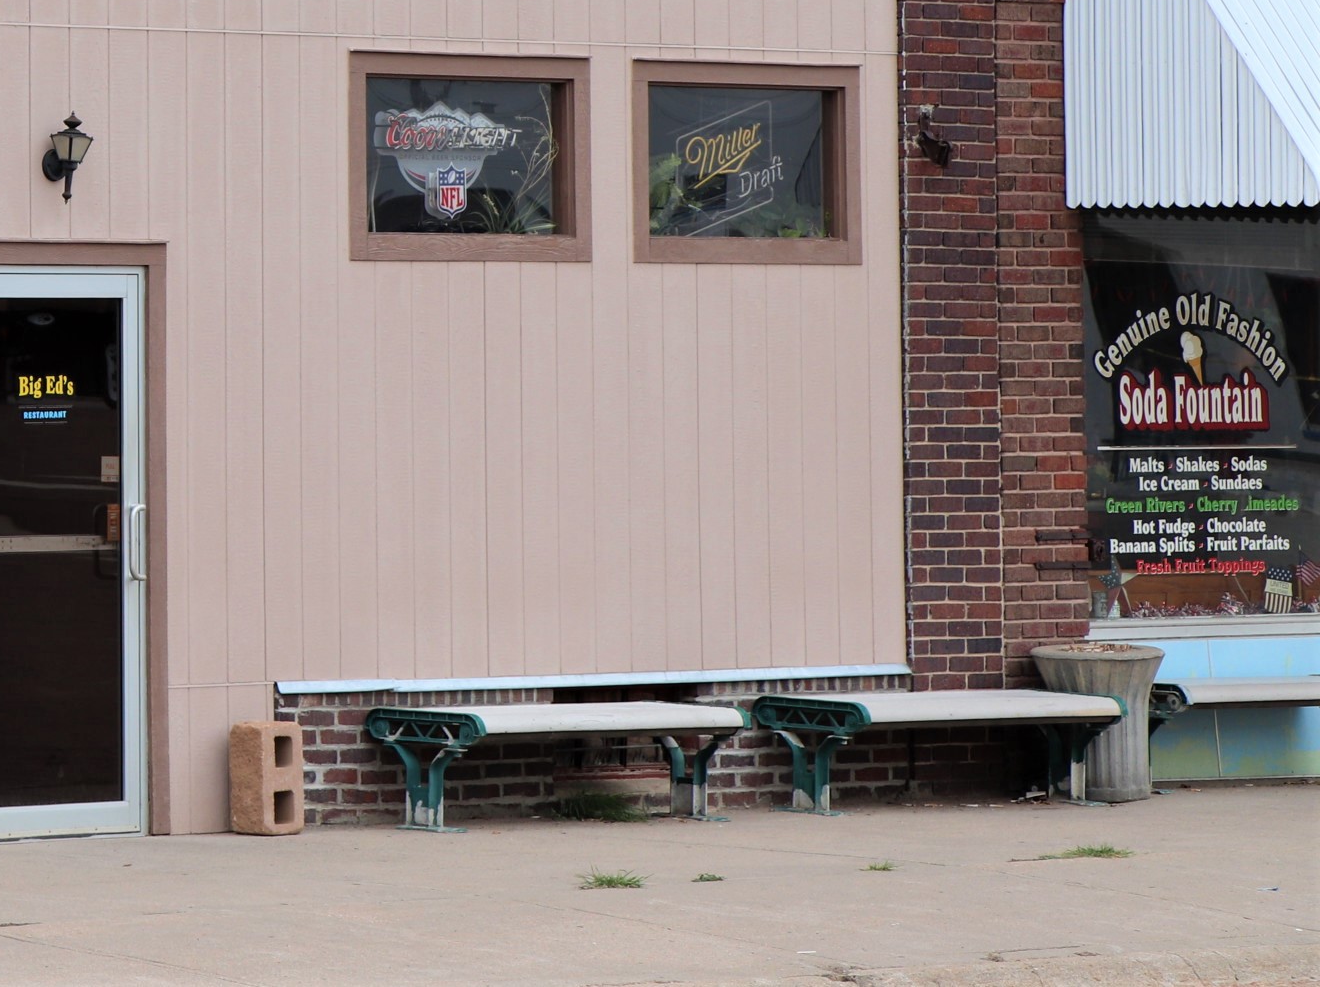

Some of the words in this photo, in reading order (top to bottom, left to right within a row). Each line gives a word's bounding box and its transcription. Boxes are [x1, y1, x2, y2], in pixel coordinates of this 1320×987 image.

[686, 123, 760, 179] Miller
[738, 156, 783, 198] Draft
[441, 187, 463, 209] NFL
[1094, 307, 1170, 378] Genuine
[1176, 293, 1211, 326] Old
[1216, 300, 1287, 381] Fashion
[18, 376, 42, 399] Big
[45, 374, 74, 396] Ed's
[1119, 369, 1171, 428] Soda
[1174, 370, 1266, 427] Fountain
[23, 410, 67, 419] RESTAURANT
[1129, 456, 1165, 473] Malts
[1175, 456, 1220, 473] Shakes
[1231, 455, 1267, 472] Sodas
[1139, 476, 1158, 492] Ice
[1161, 476, 1200, 491] Cream
[1210, 475, 1263, 491] Sundaes
[1105, 498, 1143, 514] Green
[1146, 498, 1186, 513] Rivers
[1196, 496, 1238, 515] Cherry
[1133, 520, 1156, 535] Hot
[1158, 518, 1196, 537] Fudge
[1206, 517, 1266, 533] Chocolate
[1109, 539, 1156, 554] Banana
[1159, 537, 1195, 556] Splits
[1206, 536, 1238, 552] Fruit
[1240, 535, 1290, 552] Parfaits
[1136, 559, 1171, 575] Fresh
[1174, 557, 1206, 574] Fruit
[1208, 557, 1266, 577] Toppings
